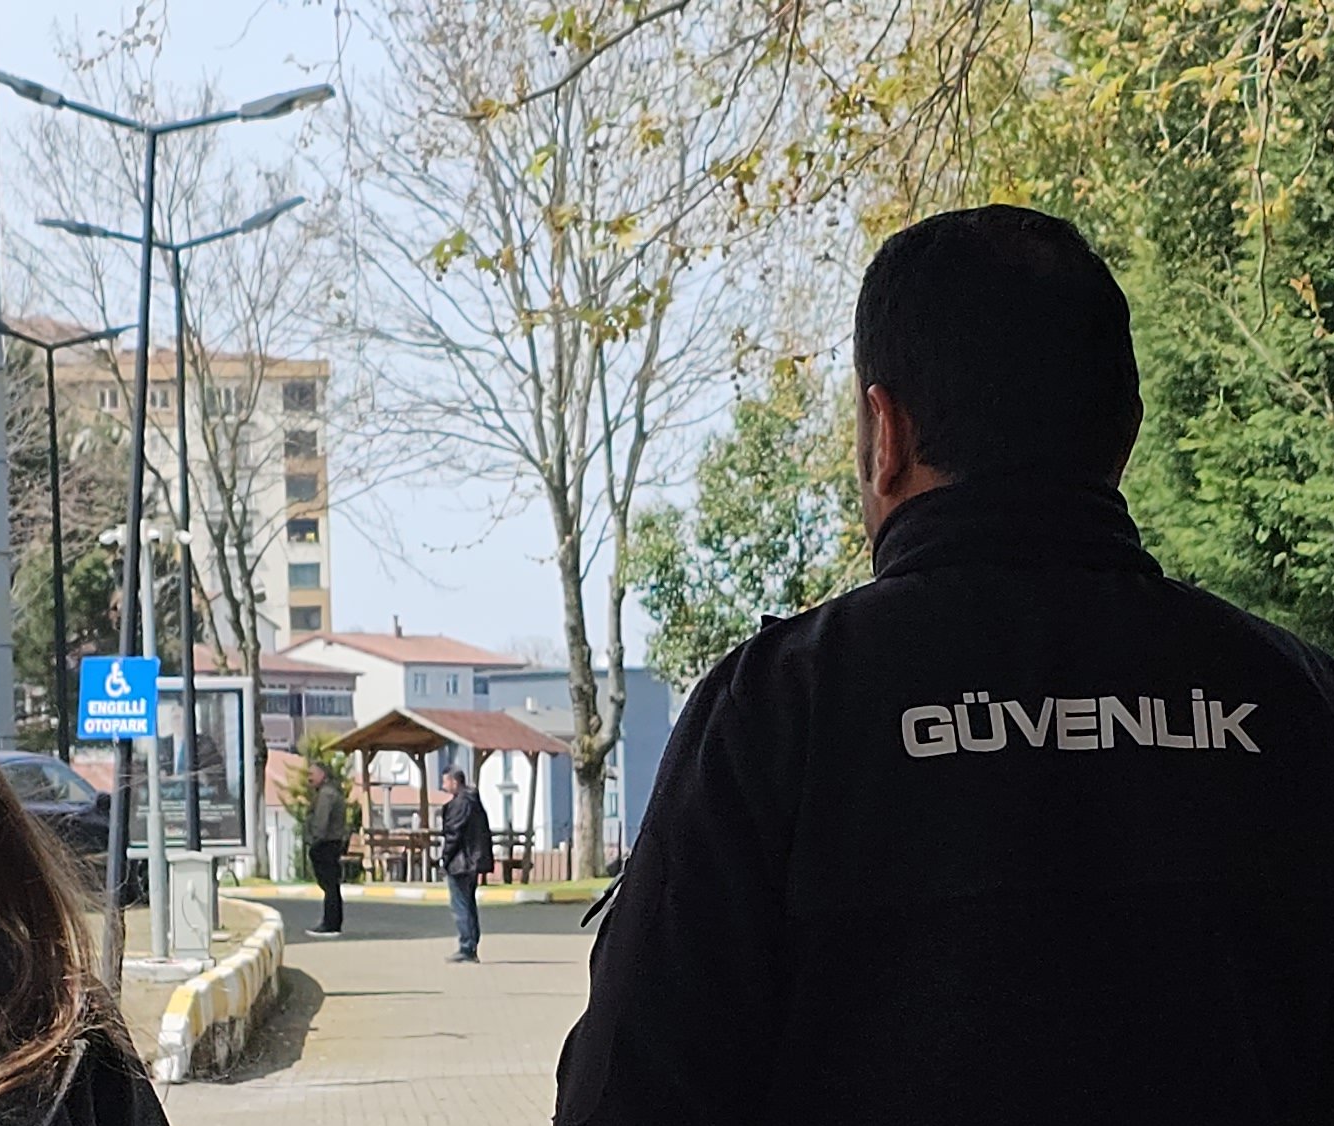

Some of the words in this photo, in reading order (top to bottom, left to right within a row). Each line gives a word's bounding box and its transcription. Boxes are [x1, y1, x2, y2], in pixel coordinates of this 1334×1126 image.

[88, 698, 147, 717] ENGELLİ
[83, 718, 148, 734] OTOPARK
[901, 688, 1261, 758] GÜVENLİK
